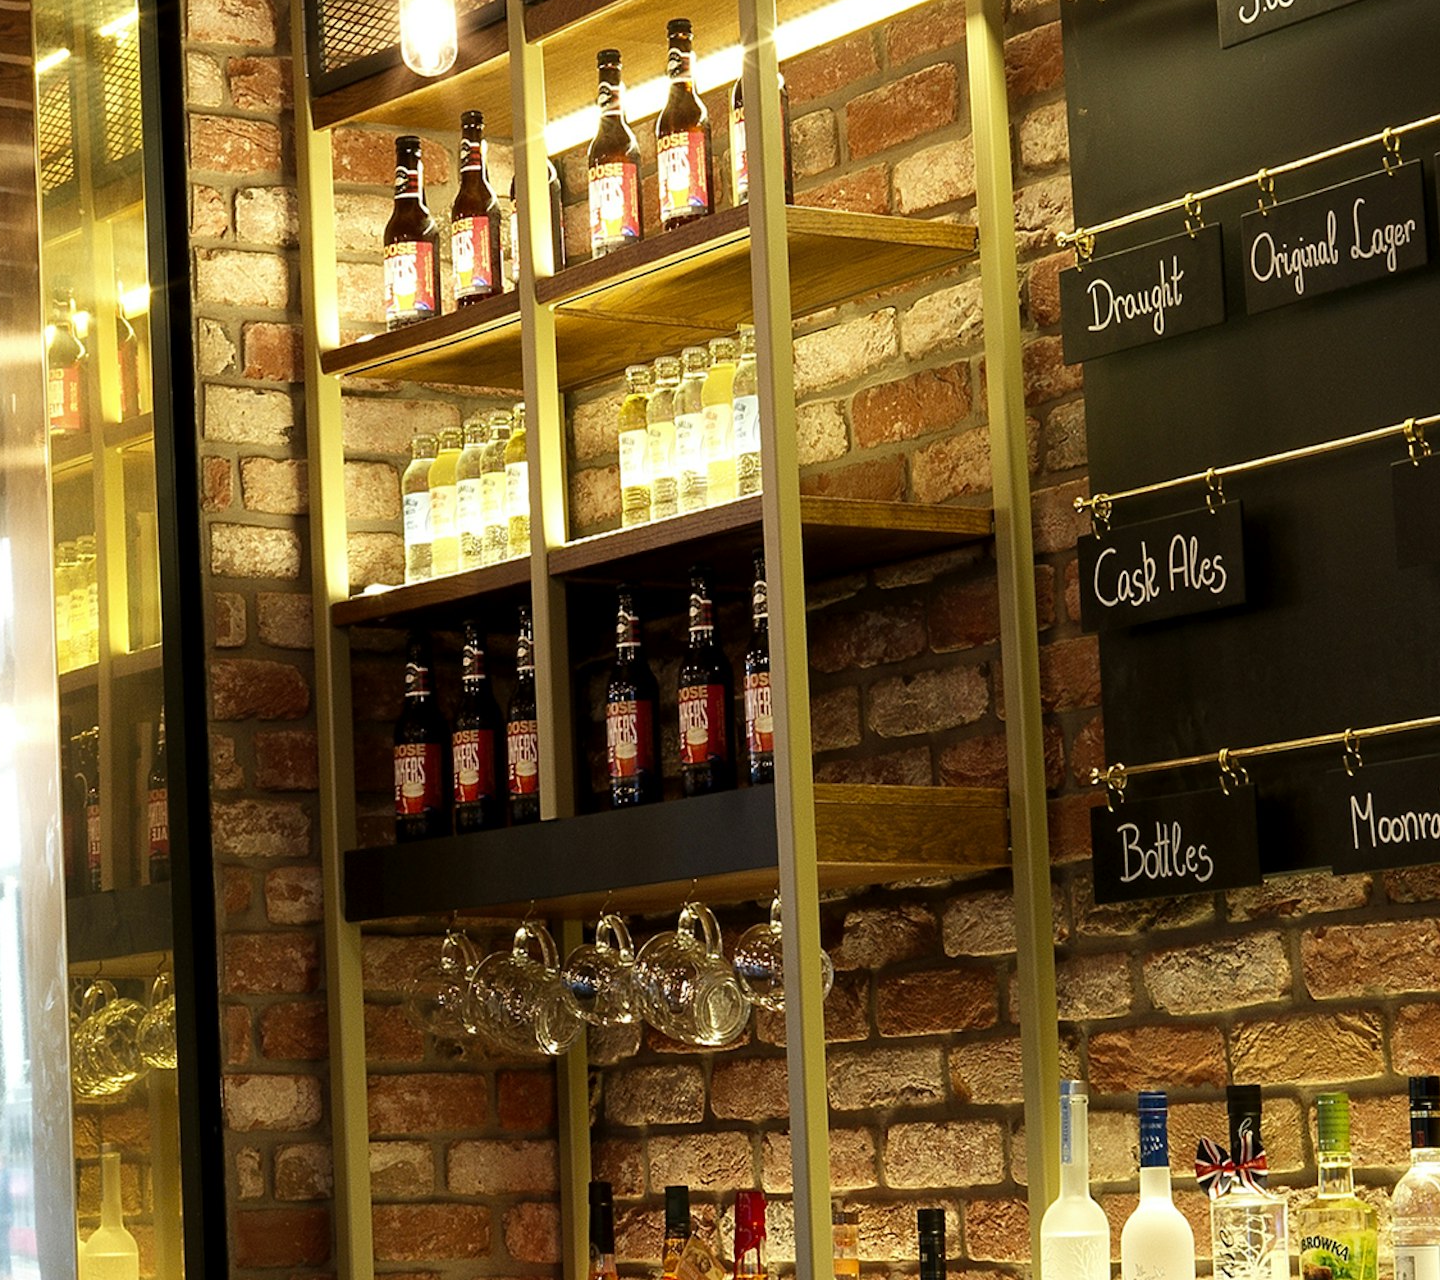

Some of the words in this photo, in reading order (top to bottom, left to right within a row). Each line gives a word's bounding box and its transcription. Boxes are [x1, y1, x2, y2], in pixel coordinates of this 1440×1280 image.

[1250, 211, 1340, 296] Original
[1350, 197, 1416, 272] Lager
[1086, 255, 1184, 335] Draught
[1093, 542, 1160, 607] Cask
[1169, 534, 1227, 595] Ales
[1116, 821, 1214, 883] Bottles
[1300, 1234, 1350, 1262] BROWKA
